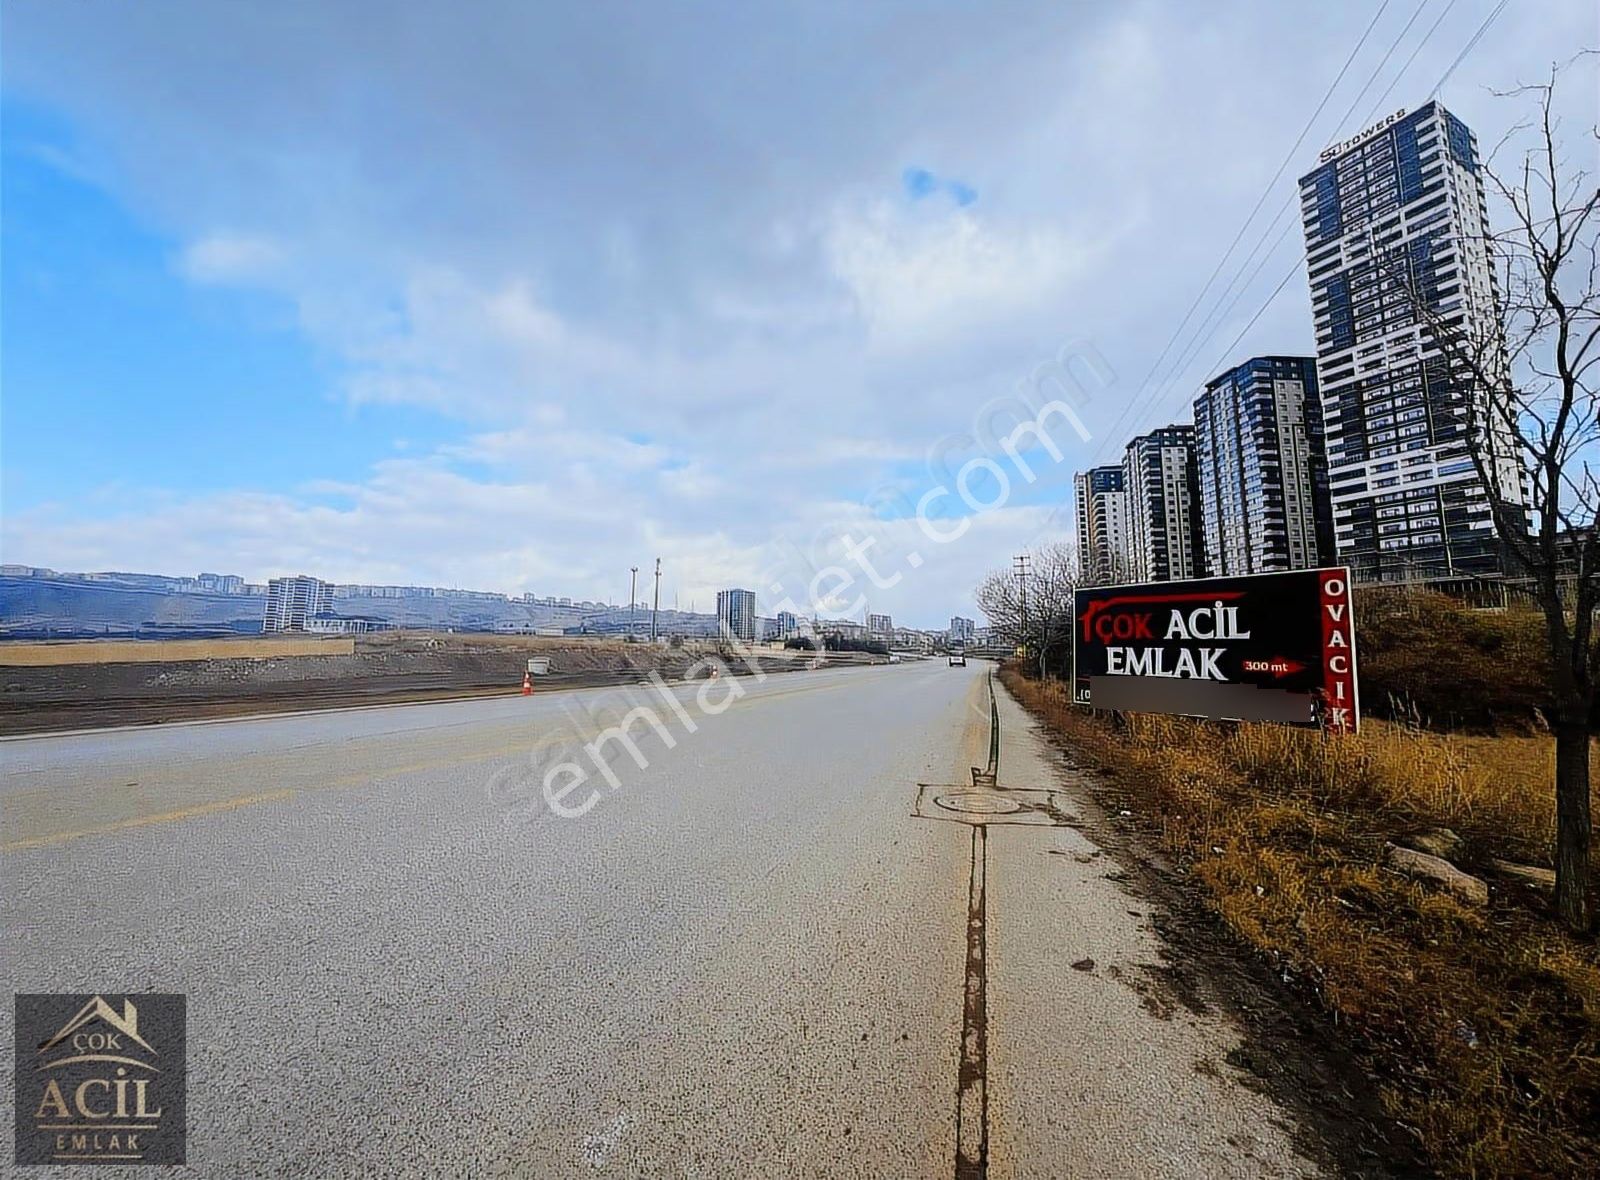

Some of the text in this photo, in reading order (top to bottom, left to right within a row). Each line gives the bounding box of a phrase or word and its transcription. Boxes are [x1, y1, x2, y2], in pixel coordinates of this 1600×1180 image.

[1344, 108, 1406, 150] TOWERS
[1095, 600, 1250, 645] ÇOK ACİL
[1106, 646, 1229, 681] EMLAK
[1244, 661, 1288, 672] 300 mt
[1324, 579, 1351, 726] OVACIK
